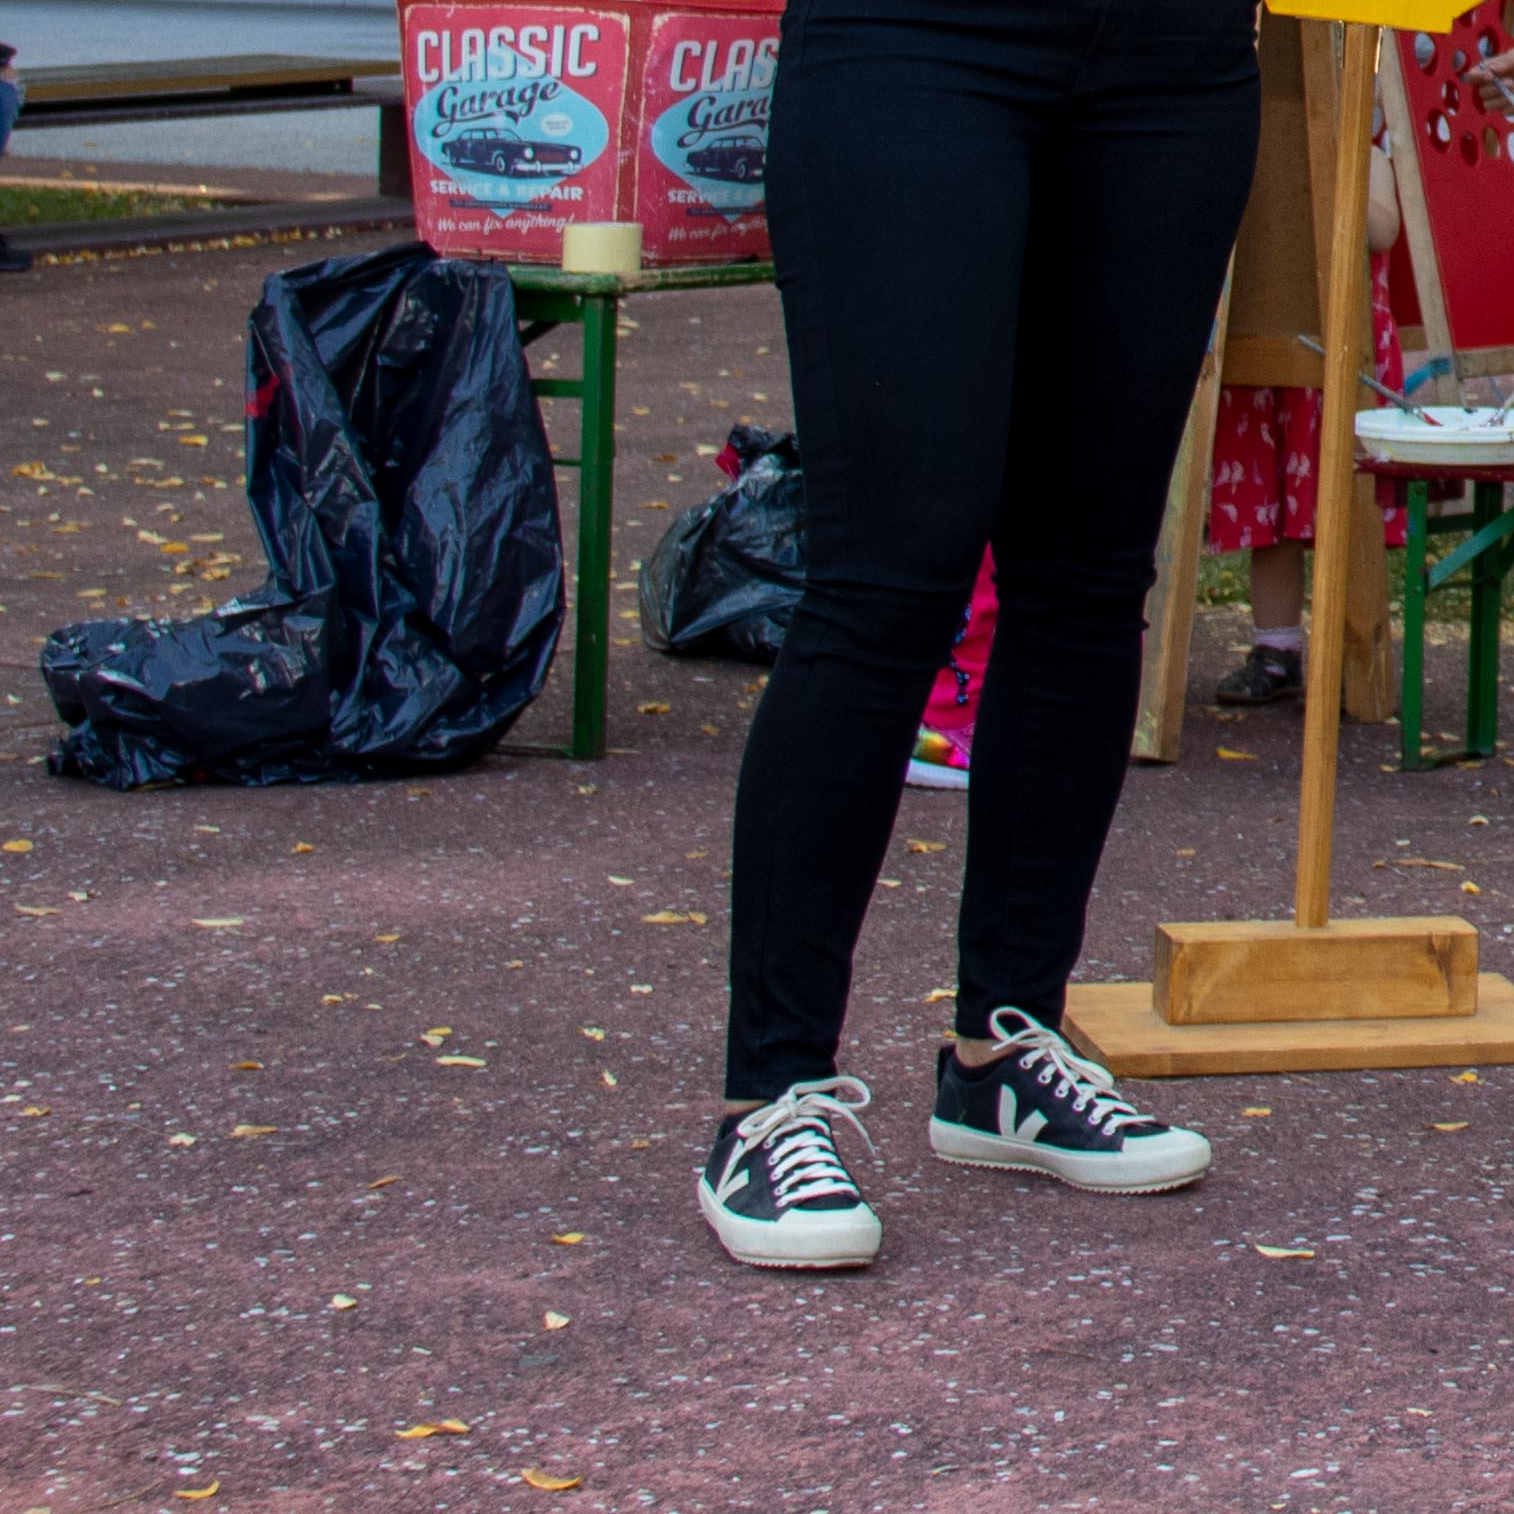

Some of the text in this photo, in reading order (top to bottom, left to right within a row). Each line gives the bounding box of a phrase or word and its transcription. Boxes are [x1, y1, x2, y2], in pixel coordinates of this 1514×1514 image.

[417, 24, 600, 83] CLASSIC
[670, 36, 780, 93] CLAS
[432, 82, 562, 137] Garage
[680, 95, 769, 142] Gara
[430, 179, 494, 198] SERVICE
[517, 184, 585, 201] REPAIR
[459, 220, 481, 232] can
[483, 217, 502, 236] fix
